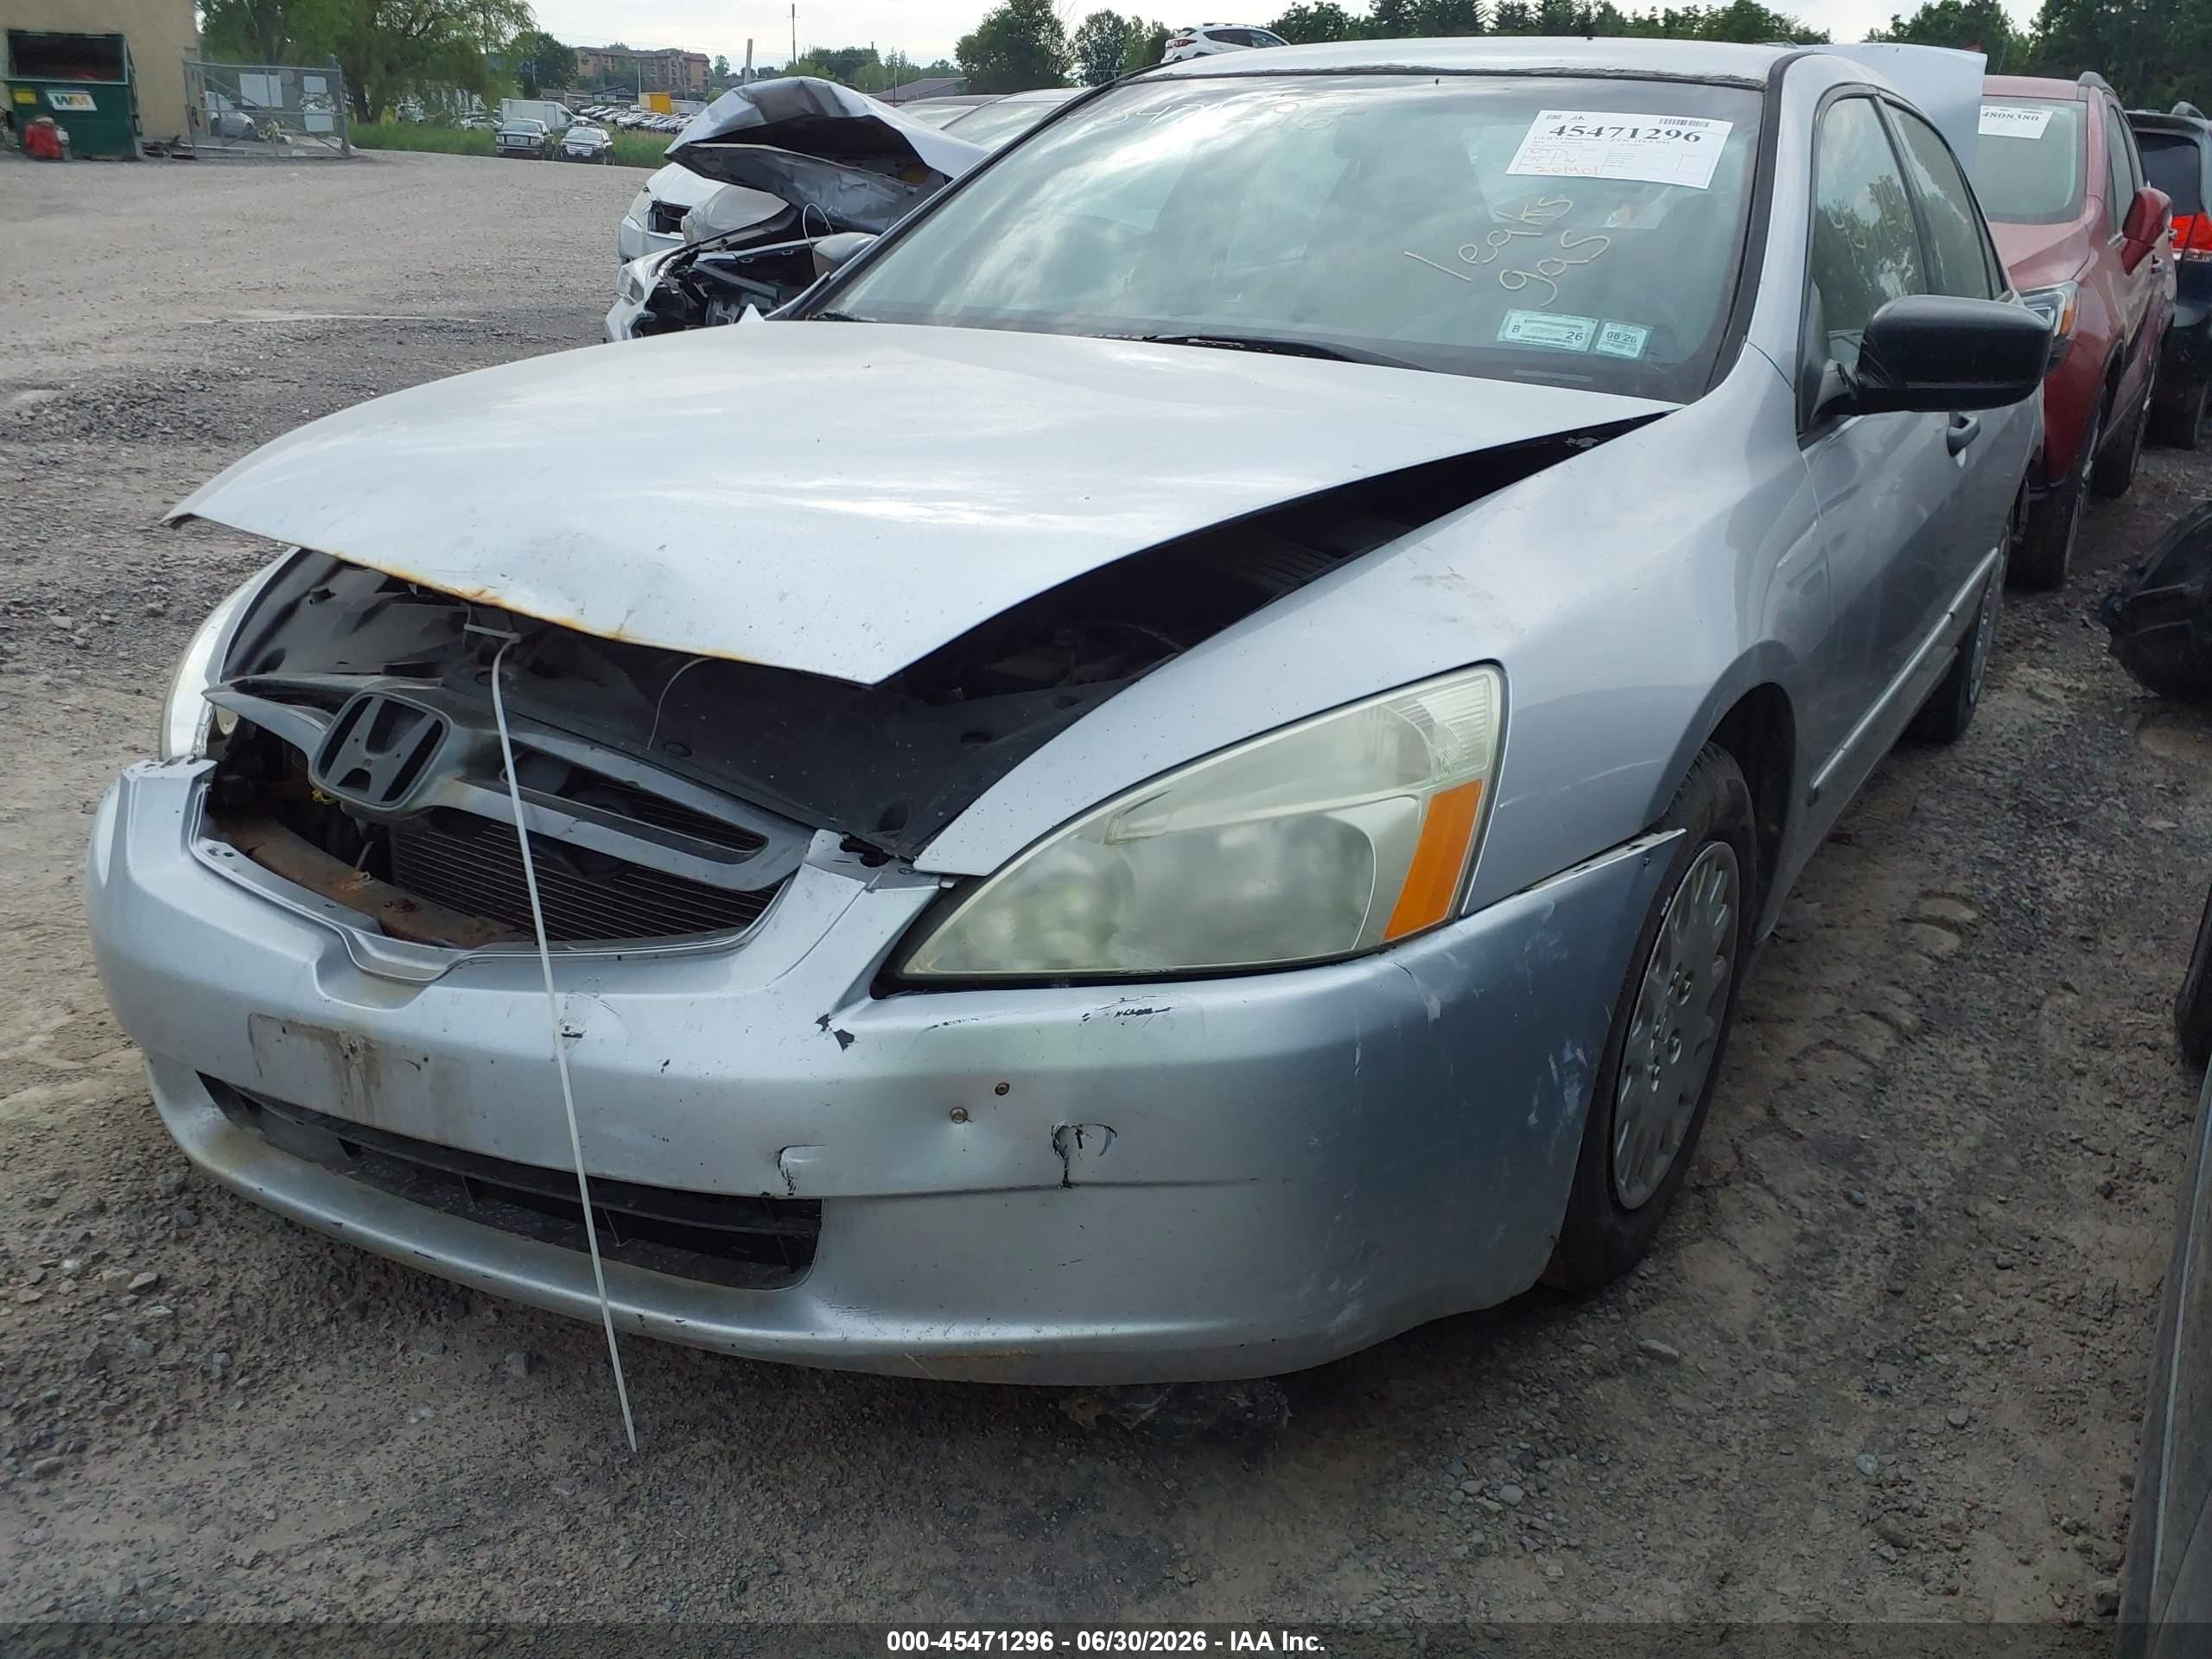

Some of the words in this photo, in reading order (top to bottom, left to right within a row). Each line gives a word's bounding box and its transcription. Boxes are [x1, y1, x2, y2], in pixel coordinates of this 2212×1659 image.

[54, 95, 89, 105] WM
[1549, 124, 1702, 143] 45471296
[1499, 230, 1611, 308] gas
[1512, 324, 1521, 333] 8
[1566, 331, 1584, 341] 26
